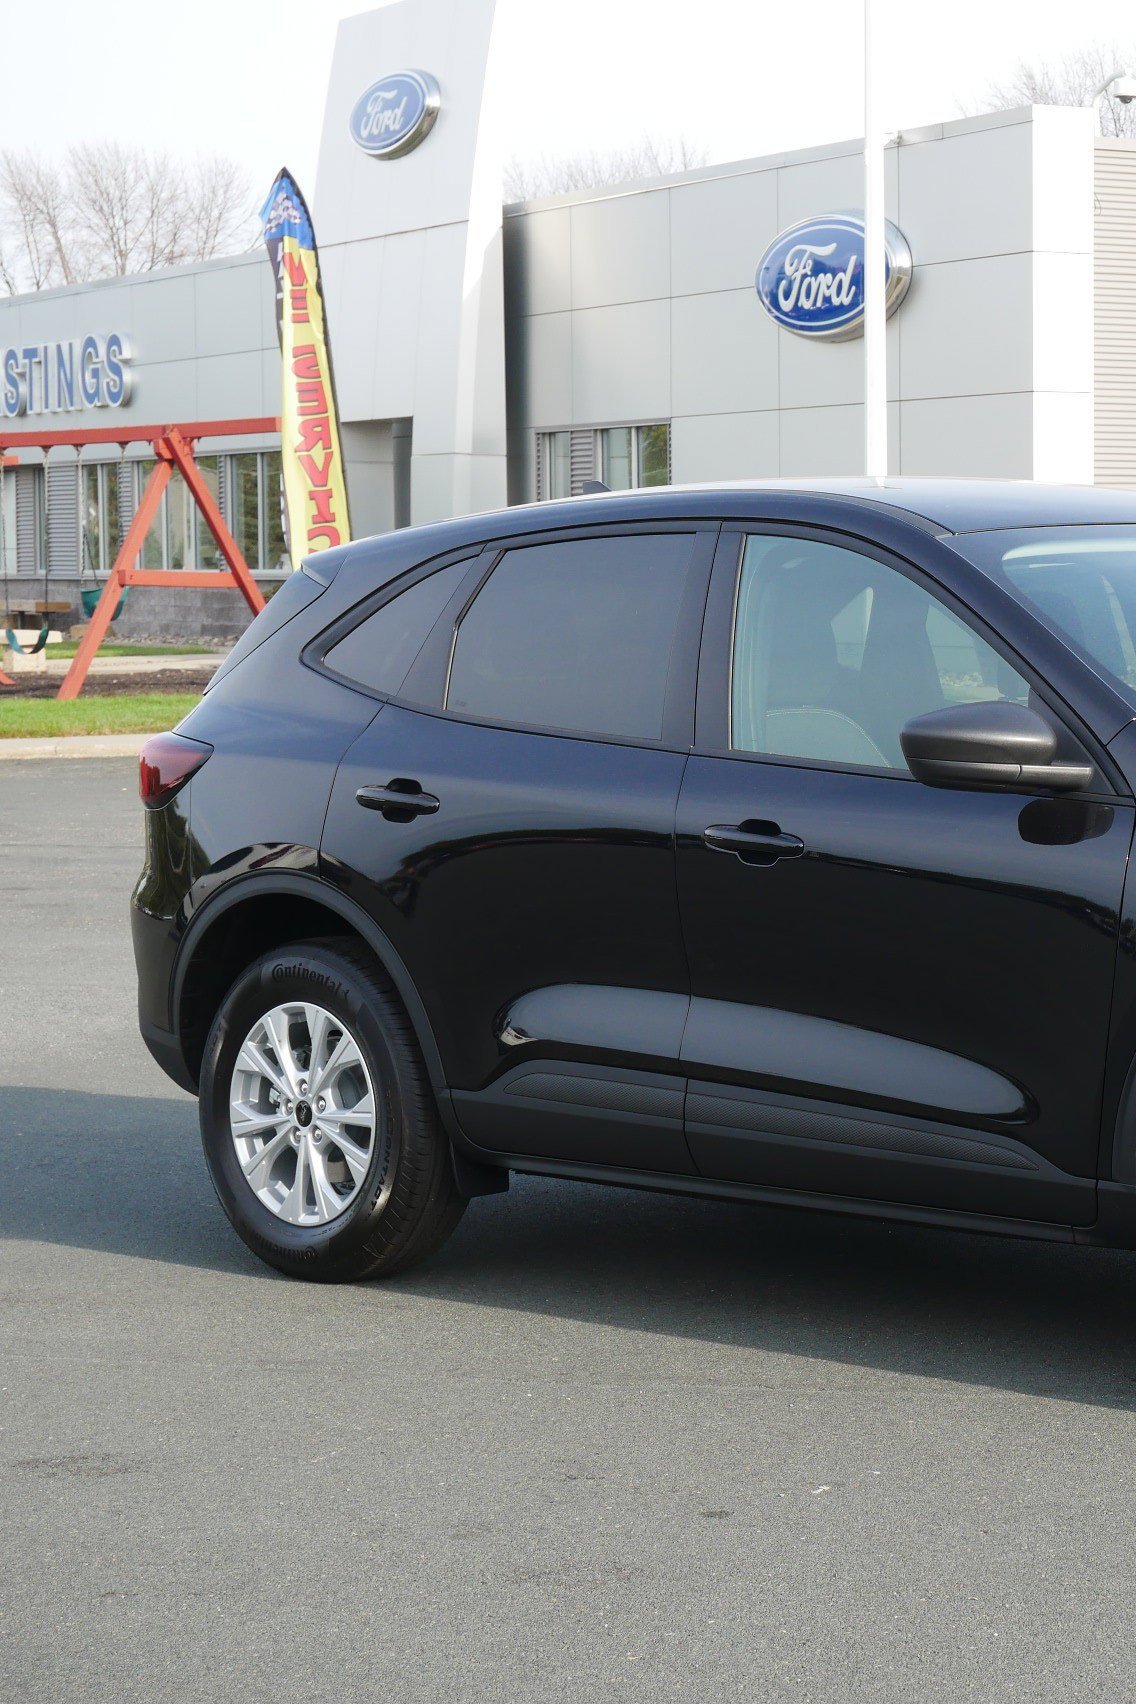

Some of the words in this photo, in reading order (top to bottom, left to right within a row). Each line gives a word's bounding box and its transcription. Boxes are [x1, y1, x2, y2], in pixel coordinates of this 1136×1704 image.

[360, 89, 408, 138] Ford
[778, 242, 857, 312] Ford
[0, 333, 126, 417] STINGS
[272, 962, 343, 996] Continental
